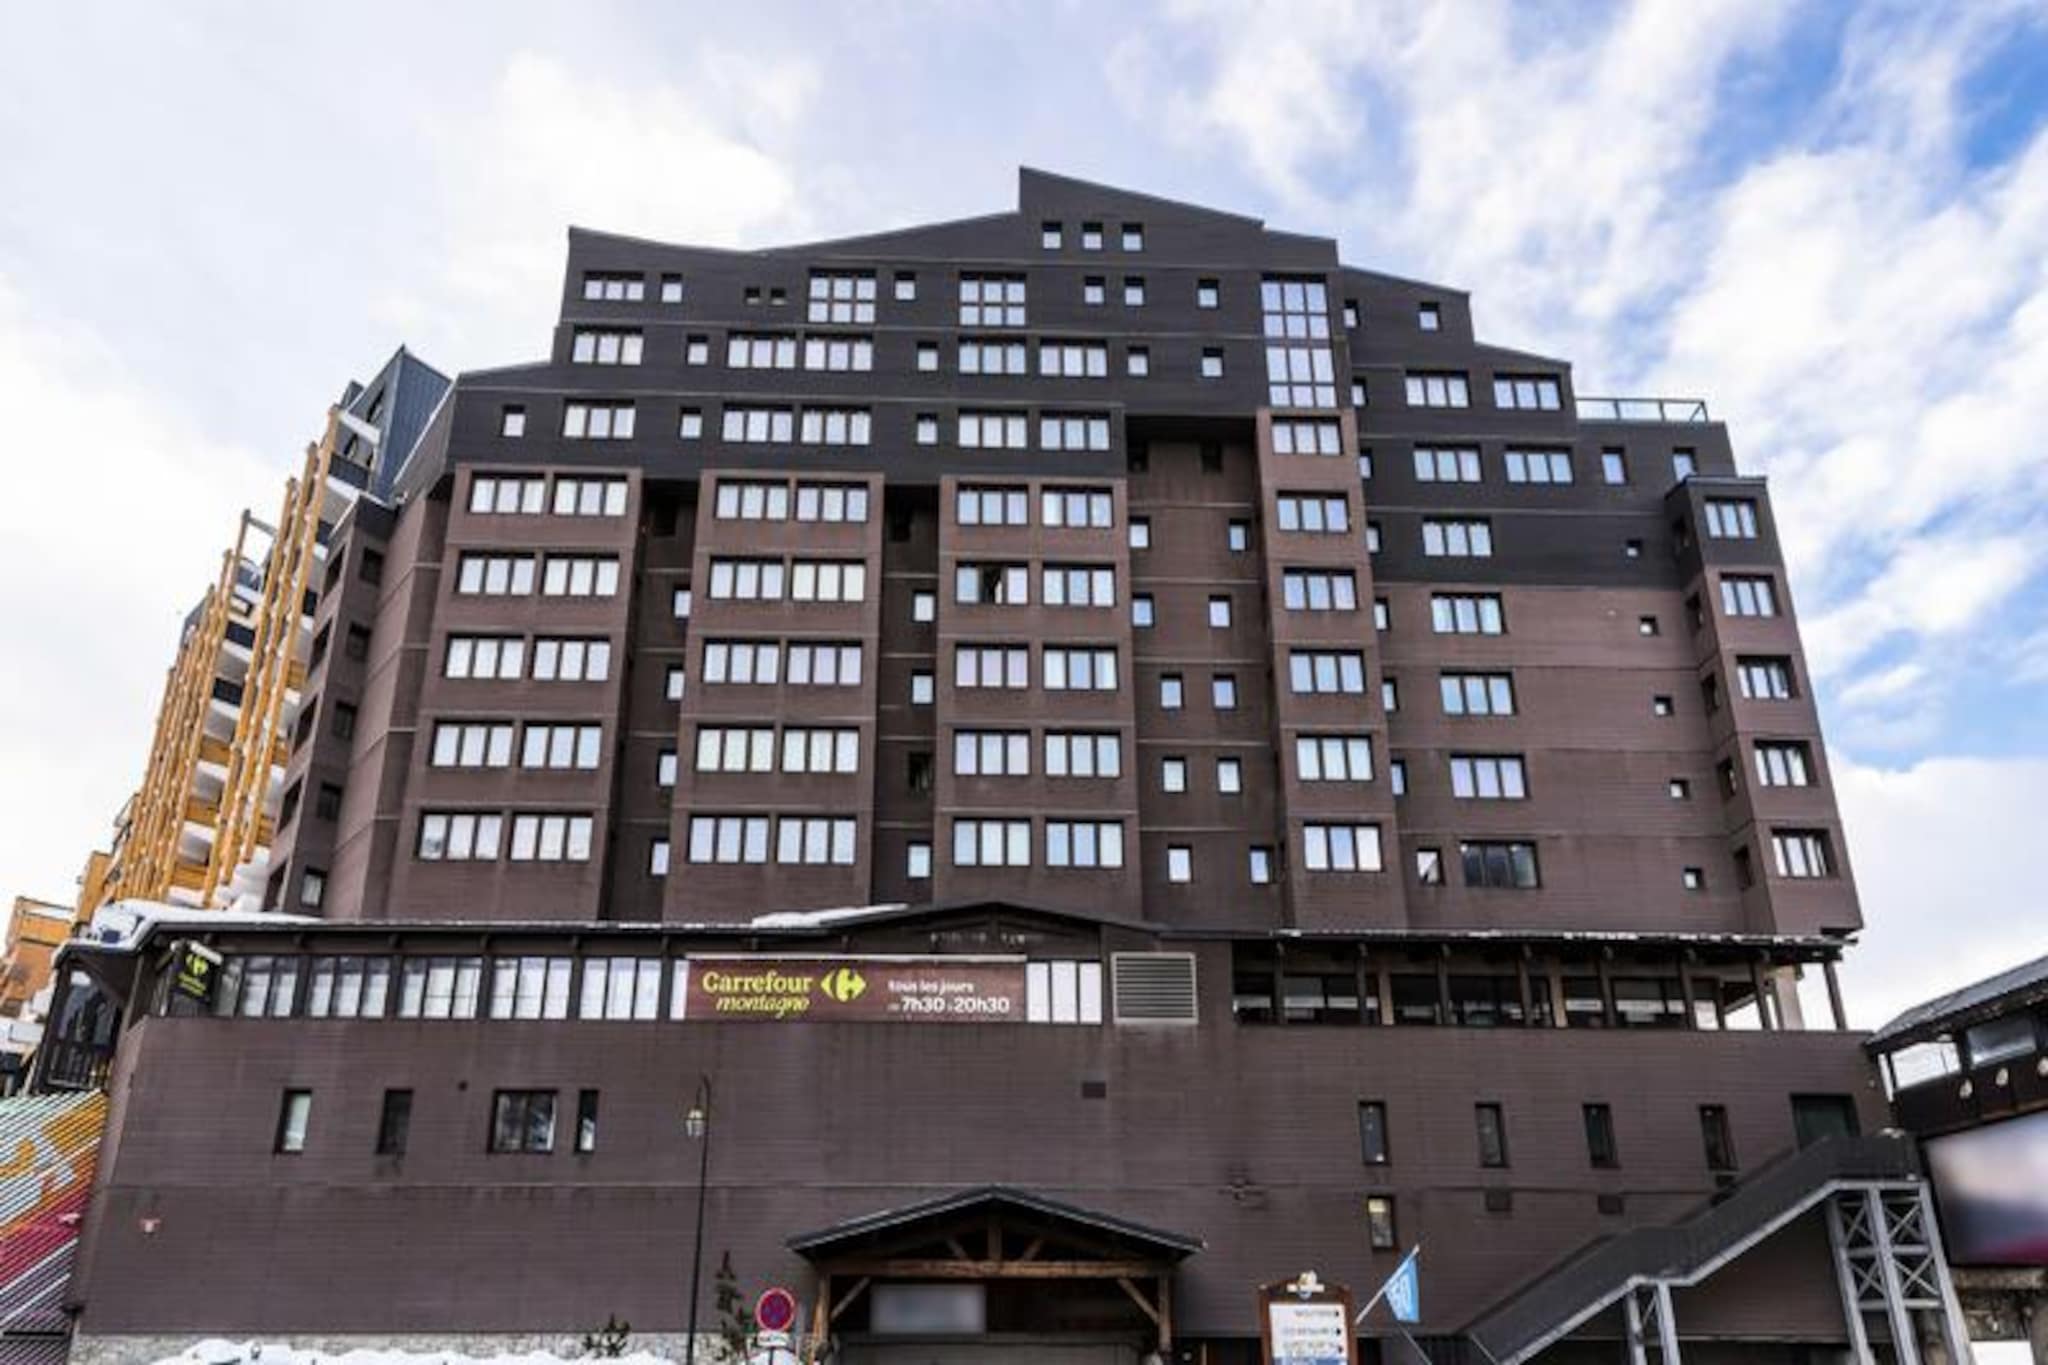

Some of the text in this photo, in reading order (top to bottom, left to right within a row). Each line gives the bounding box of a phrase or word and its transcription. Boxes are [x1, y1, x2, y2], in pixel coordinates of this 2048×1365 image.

[702, 970, 814, 993] Carrefour
[938, 979, 975, 996] jours
[715, 995, 811, 1019] montagne
[901, 997, 946, 1013] 7h30
[954, 997, 1010, 1013] 20h30
